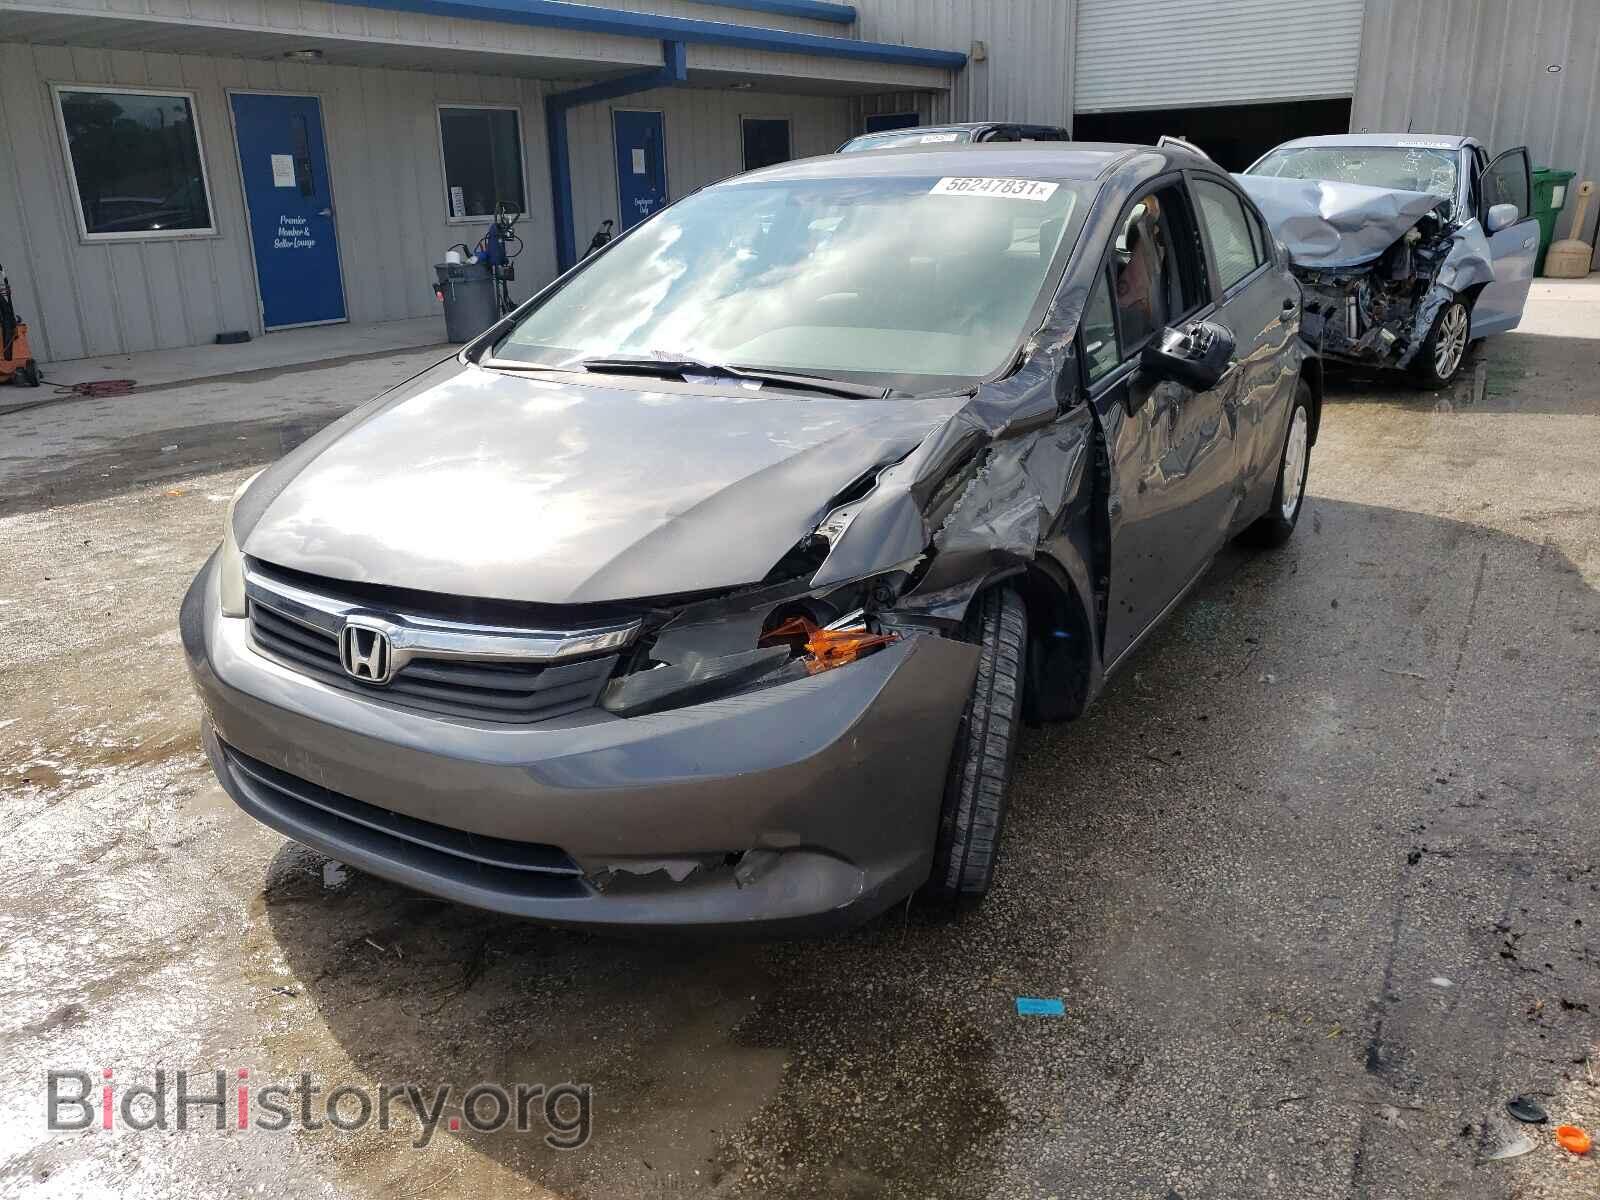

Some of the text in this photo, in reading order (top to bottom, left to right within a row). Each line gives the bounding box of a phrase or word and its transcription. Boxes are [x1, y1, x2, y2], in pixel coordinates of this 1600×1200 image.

[280, 215, 307, 225] Premier
[278, 226, 311, 237] Member &
[293, 237, 316, 249] Lounge
